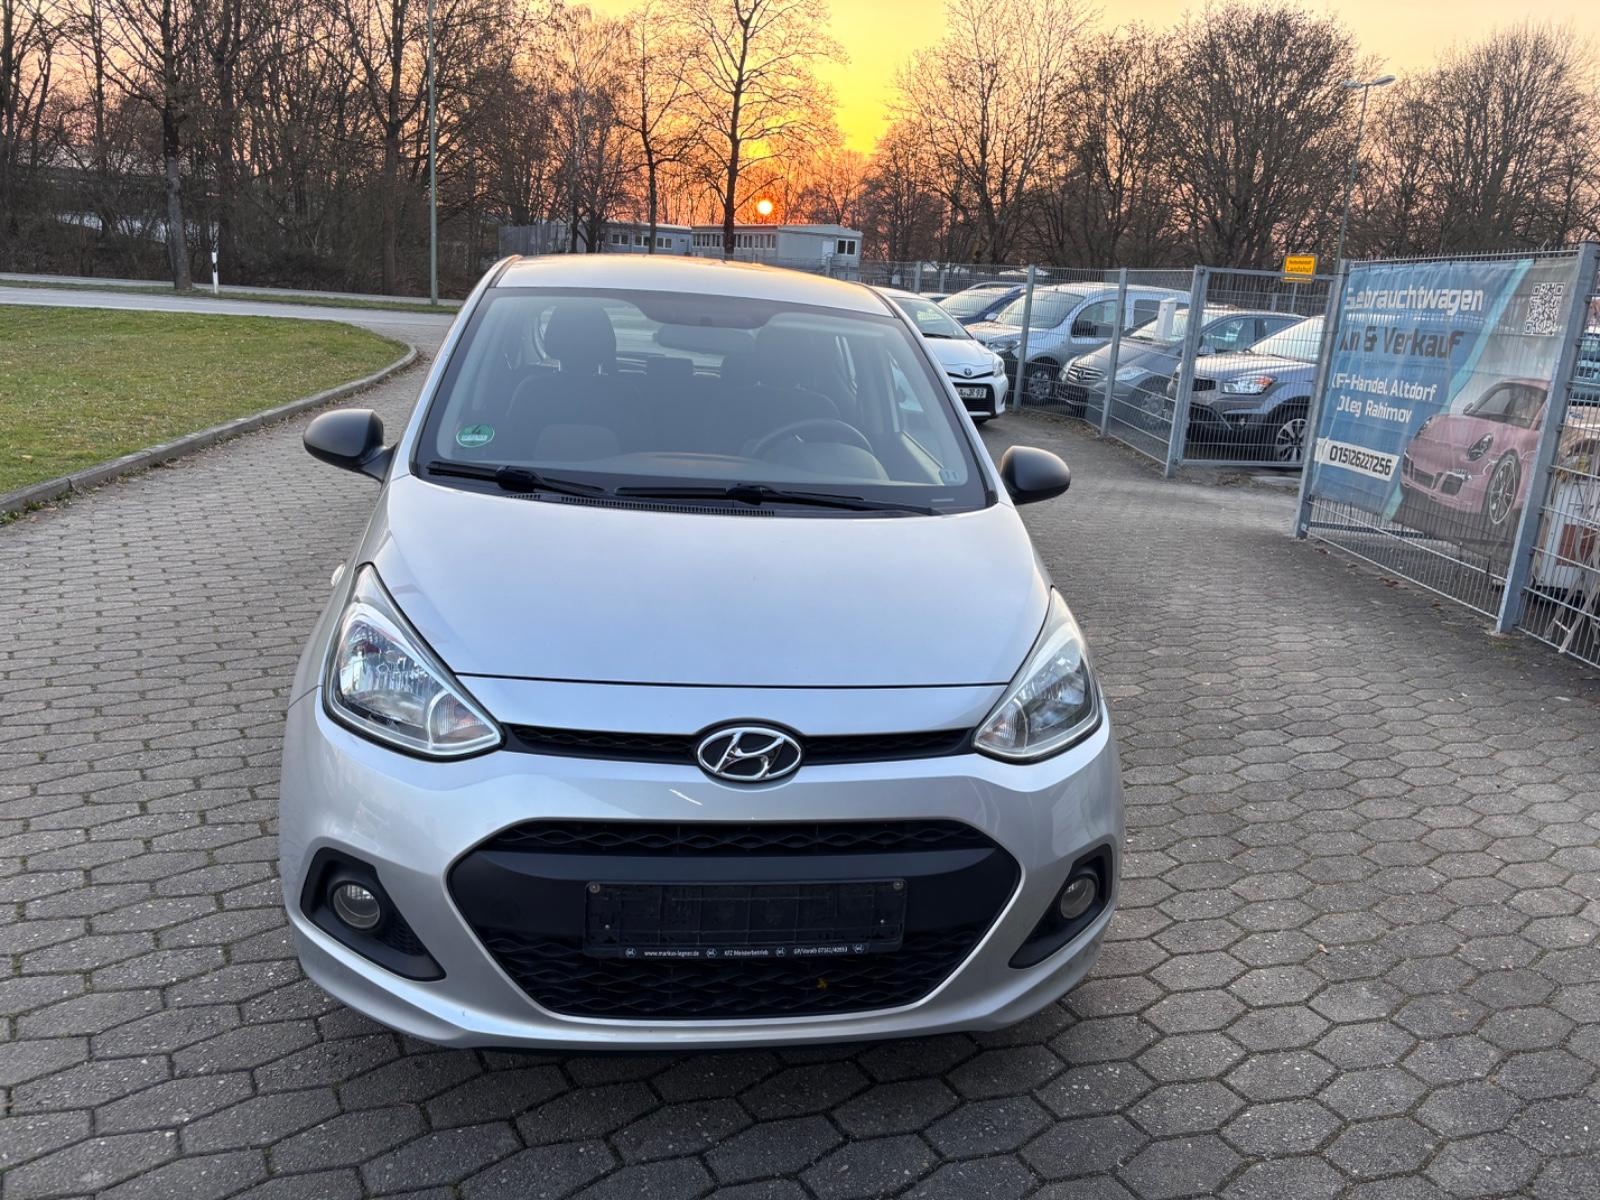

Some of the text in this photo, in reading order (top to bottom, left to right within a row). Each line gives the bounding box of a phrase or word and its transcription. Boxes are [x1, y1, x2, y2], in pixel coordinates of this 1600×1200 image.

[1383, 326, 1464, 358] Verkauf
[1390, 379, 1437, 402] Altdorf
[1365, 400, 1412, 423] Rahimov
